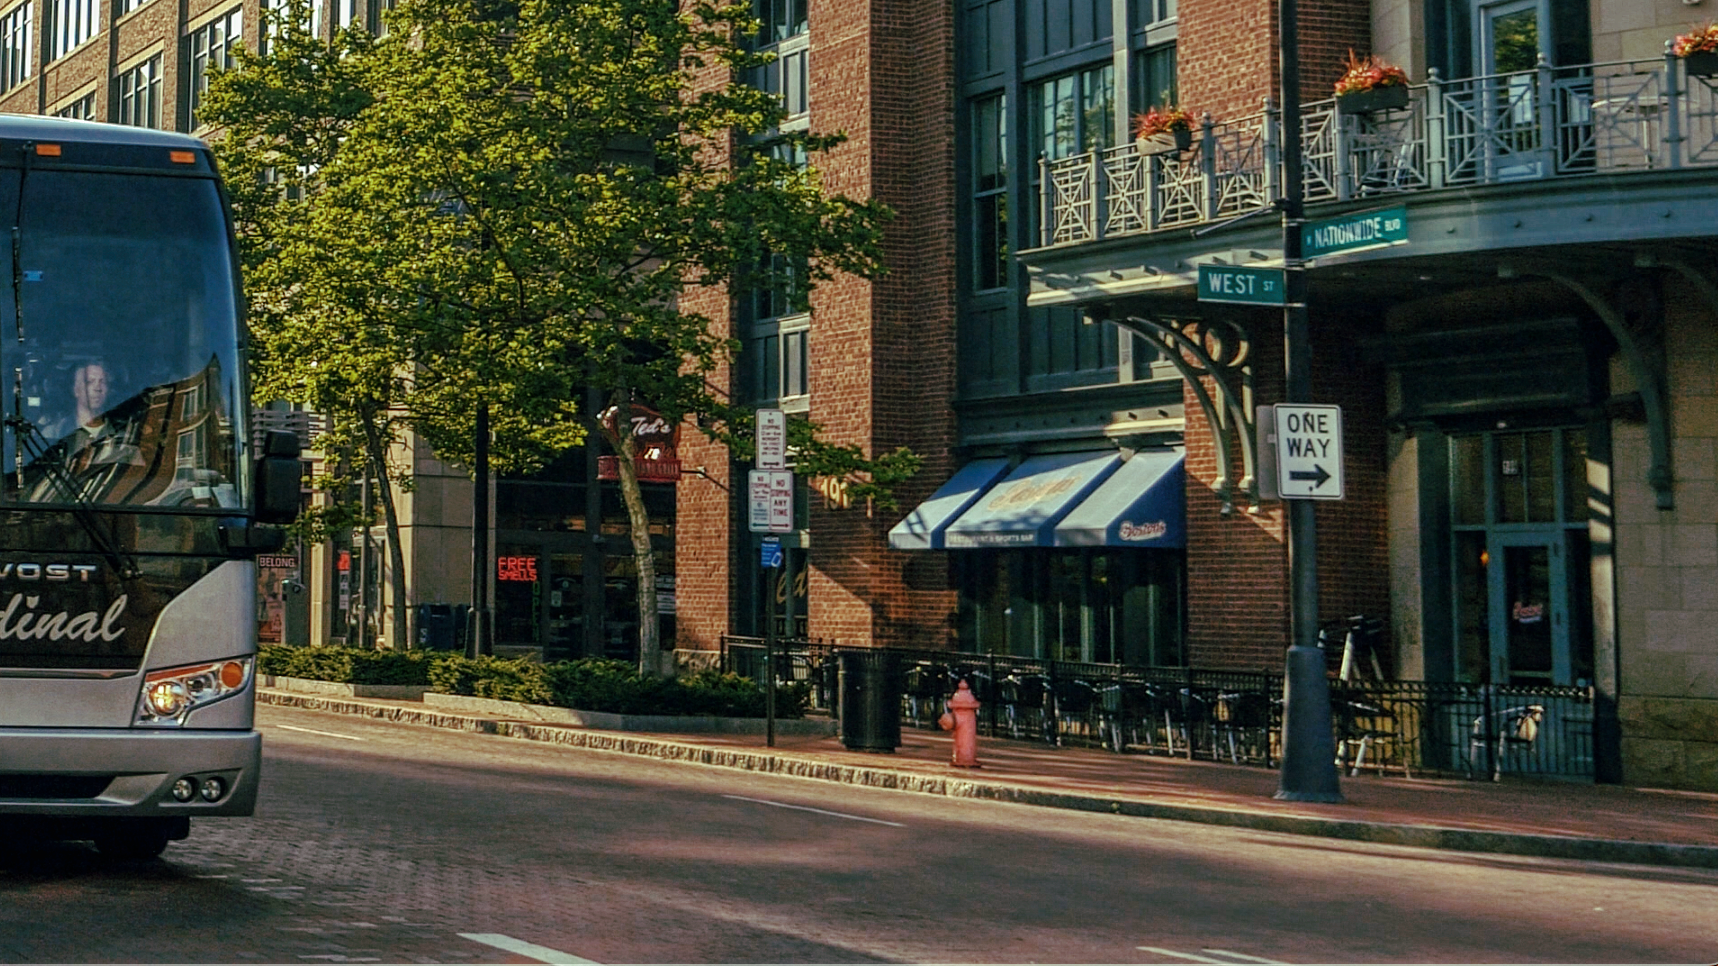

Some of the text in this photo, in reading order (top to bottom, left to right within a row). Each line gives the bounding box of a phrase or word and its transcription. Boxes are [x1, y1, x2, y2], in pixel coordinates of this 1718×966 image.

[1315, 217, 1382, 248] NATIONWIDE
[1385, 218, 1401, 231] BLVD
[1208, 273, 1274, 295] WEST ST
[631, 417, 671, 436] Ted's
[1287, 413, 1329, 434] ONE
[1287, 438, 1330, 458] WAY
[776, 479, 785, 487] NO
[498, 557, 536, 571] FREE
[498, 570, 537, 581] SMELLS
